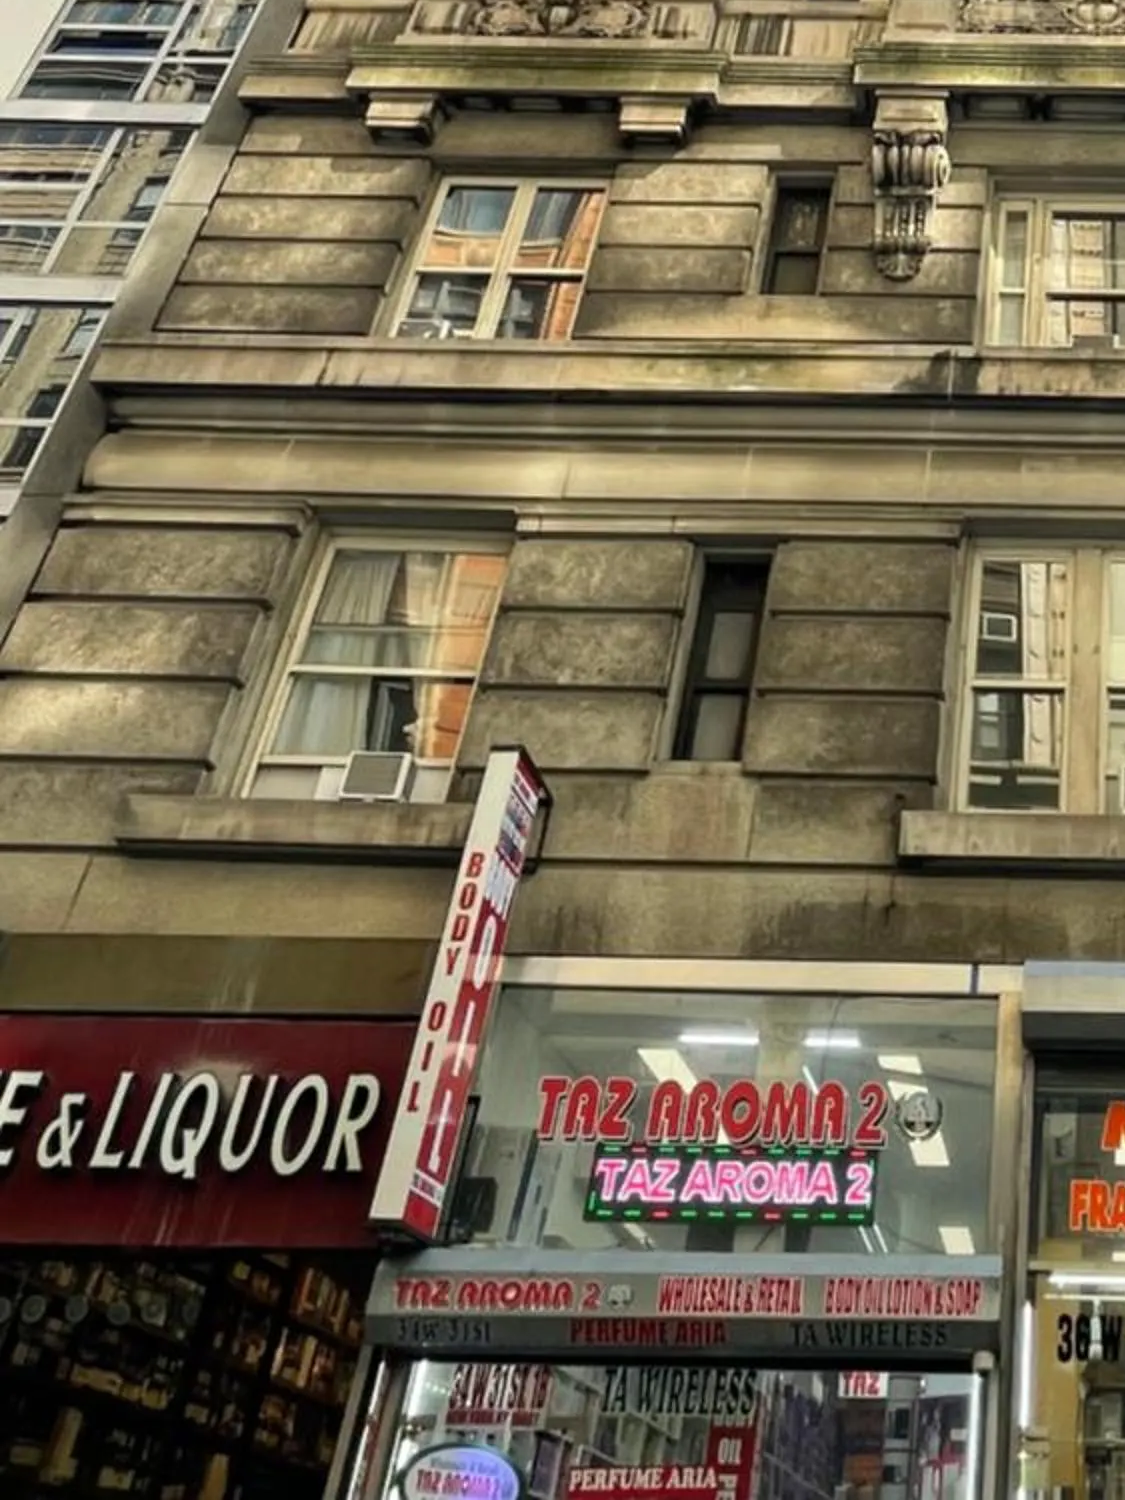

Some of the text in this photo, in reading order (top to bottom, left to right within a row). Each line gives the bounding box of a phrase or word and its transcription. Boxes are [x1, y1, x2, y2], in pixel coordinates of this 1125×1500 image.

[446, 852, 485, 976] BODY
[407, 1002, 447, 1112] OIL
[36, 1093, 86, 1169] &
[89, 1071, 380, 1179] LIQUOR
[537, 1076, 888, 1148] TAZ AROMA 2
[596, 1157, 872, 1204] TAZ AROMA 2
[394, 1278, 600, 1312] TAZ AROMA 2
[659, 1276, 741, 1313] WHOLESALE
[756, 1276, 803, 1313] RETAIL
[945, 1279, 982, 1316] SOAP
[570, 1318, 727, 1344] PERFUME ARIA
[789, 1321, 948, 1347] TA WIRELESS
[602, 1367, 757, 1415] TA WIRELESS
[569, 1467, 664, 1492] PERFUME
[666, 1467, 717, 1489] ARIA
